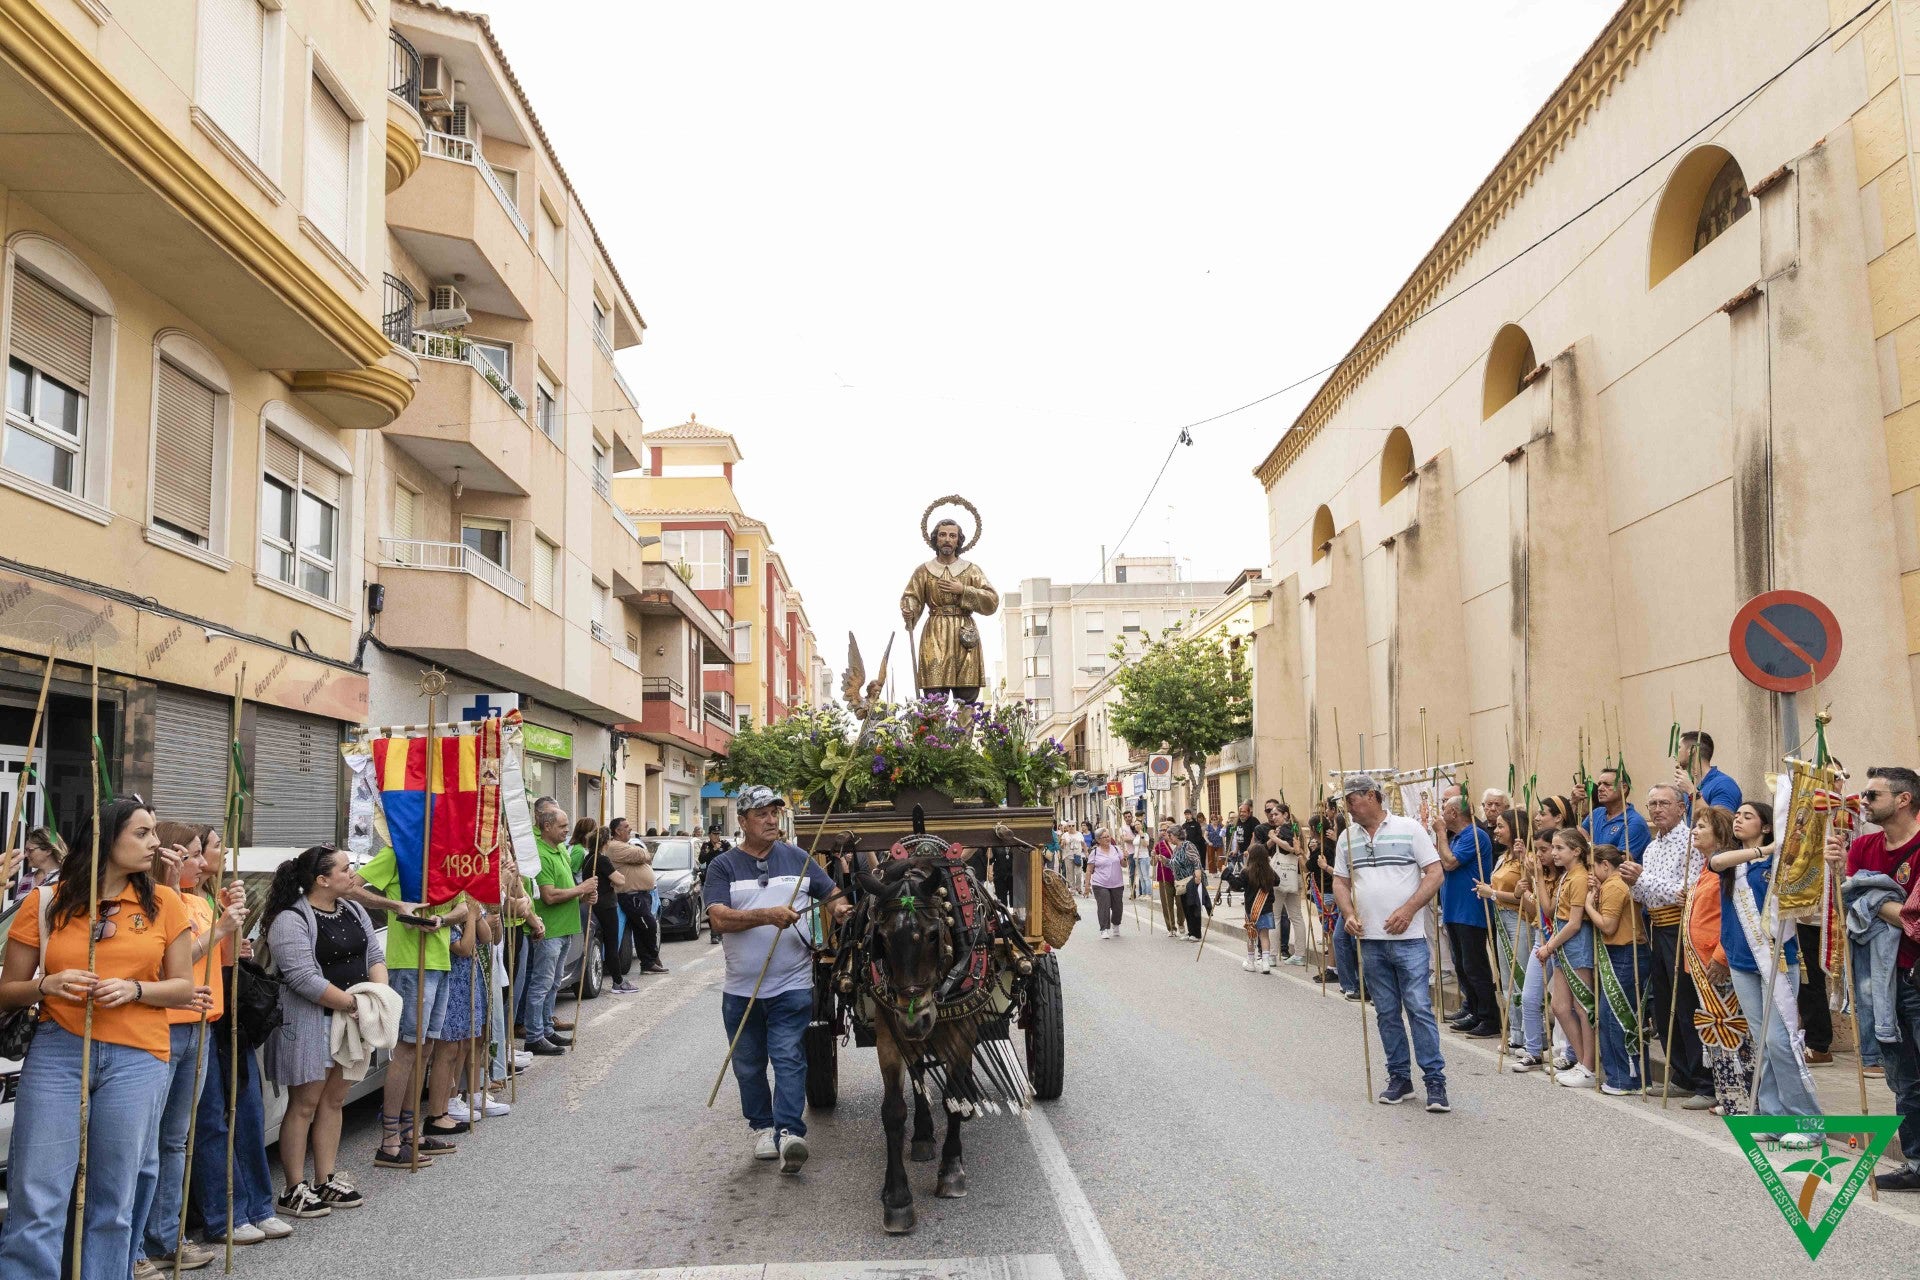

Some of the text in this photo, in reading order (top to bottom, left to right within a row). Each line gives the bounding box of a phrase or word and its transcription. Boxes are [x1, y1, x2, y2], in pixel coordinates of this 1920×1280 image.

[145, 624, 183, 669] juguetes
[213, 645, 240, 678] menaje
[440, 853, 485, 879] 1980
